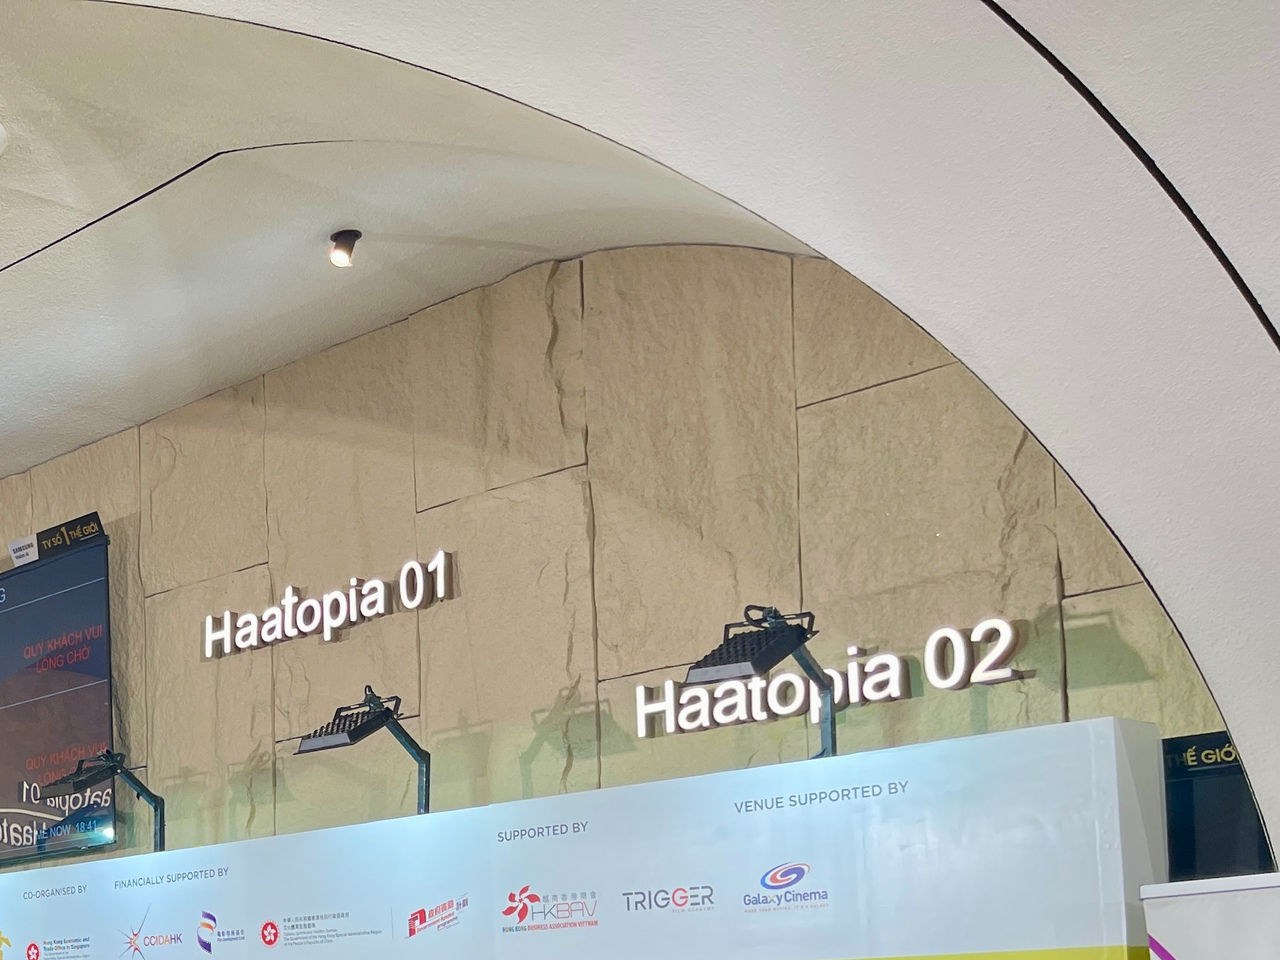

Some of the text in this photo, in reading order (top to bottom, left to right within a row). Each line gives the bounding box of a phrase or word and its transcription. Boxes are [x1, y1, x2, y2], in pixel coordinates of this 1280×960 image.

[13, 543, 34, 554] SAMSUNG
[42, 540, 52, 549] TV
[60, 527, 70, 545] 1
[205, 550, 446, 658] Haatopia 01
[85, 624, 103, 640] VUI
[636, 617, 1013, 738] Haatopia 02
[1201, 743, 1236, 764] GIỚ
[734, 780, 909, 814] VENUE SUPPORTED BY
[50, 824, 71, 838] NOW
[75, 819, 97, 834] 18:41
[497, 821, 589, 843] SUPPORTED BY
[114, 867, 229, 890] FINANCIALLY SUPPORTED BY
[23, 884, 87, 900] CO-ORGANISED BY
[622, 885, 715, 911] TRIGGER
[743, 890, 828, 906] Galaxy Cinema
[531, 900, 597, 921] HKBAV
[515, 925, 527, 933] KONG
[527, 923, 548, 932] BUSINESS
[549, 921, 577, 930] ASSOCIATION
[578, 920, 599, 928] VIETNAM
[143, 933, 183, 947] CCIDAHK
